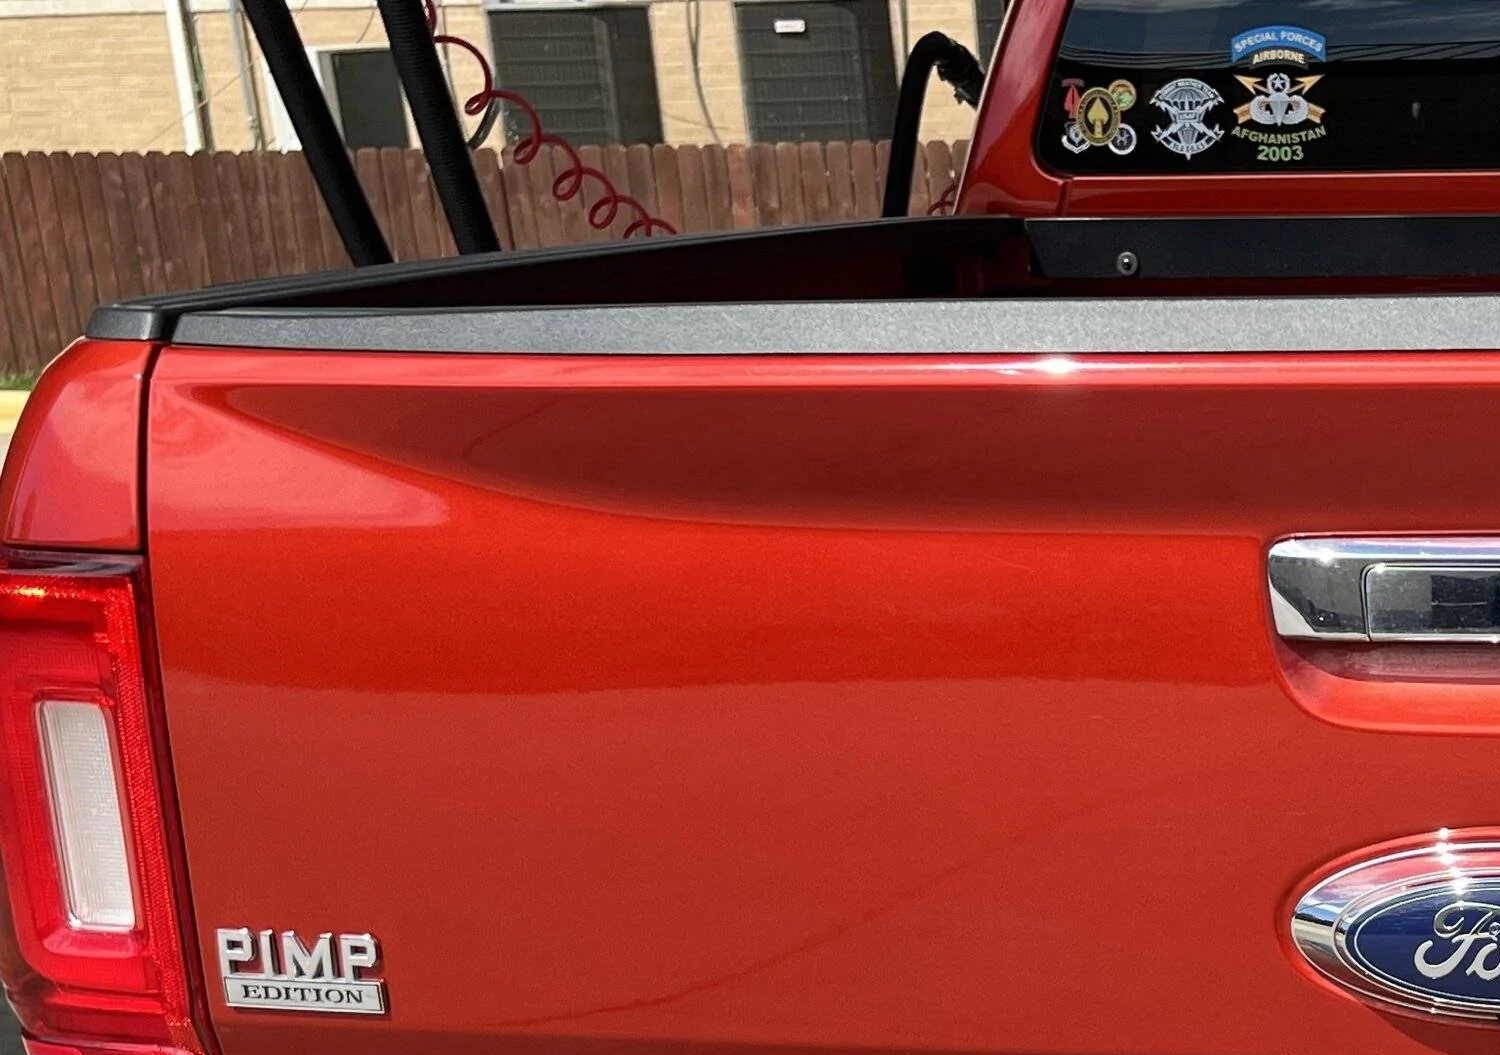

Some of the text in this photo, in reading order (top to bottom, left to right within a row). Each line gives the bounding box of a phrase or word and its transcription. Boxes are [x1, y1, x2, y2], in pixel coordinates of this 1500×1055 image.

[1234, 31, 1323, 52] SPECIAL FORCES
[1252, 49, 1306, 64] AIRBORNE
[1231, 124, 1327, 145] AFGHANISTAN
[1257, 145, 1304, 161] 2003
[216, 927, 380, 983] PIMP
[241, 984, 364, 1004] EDITION
